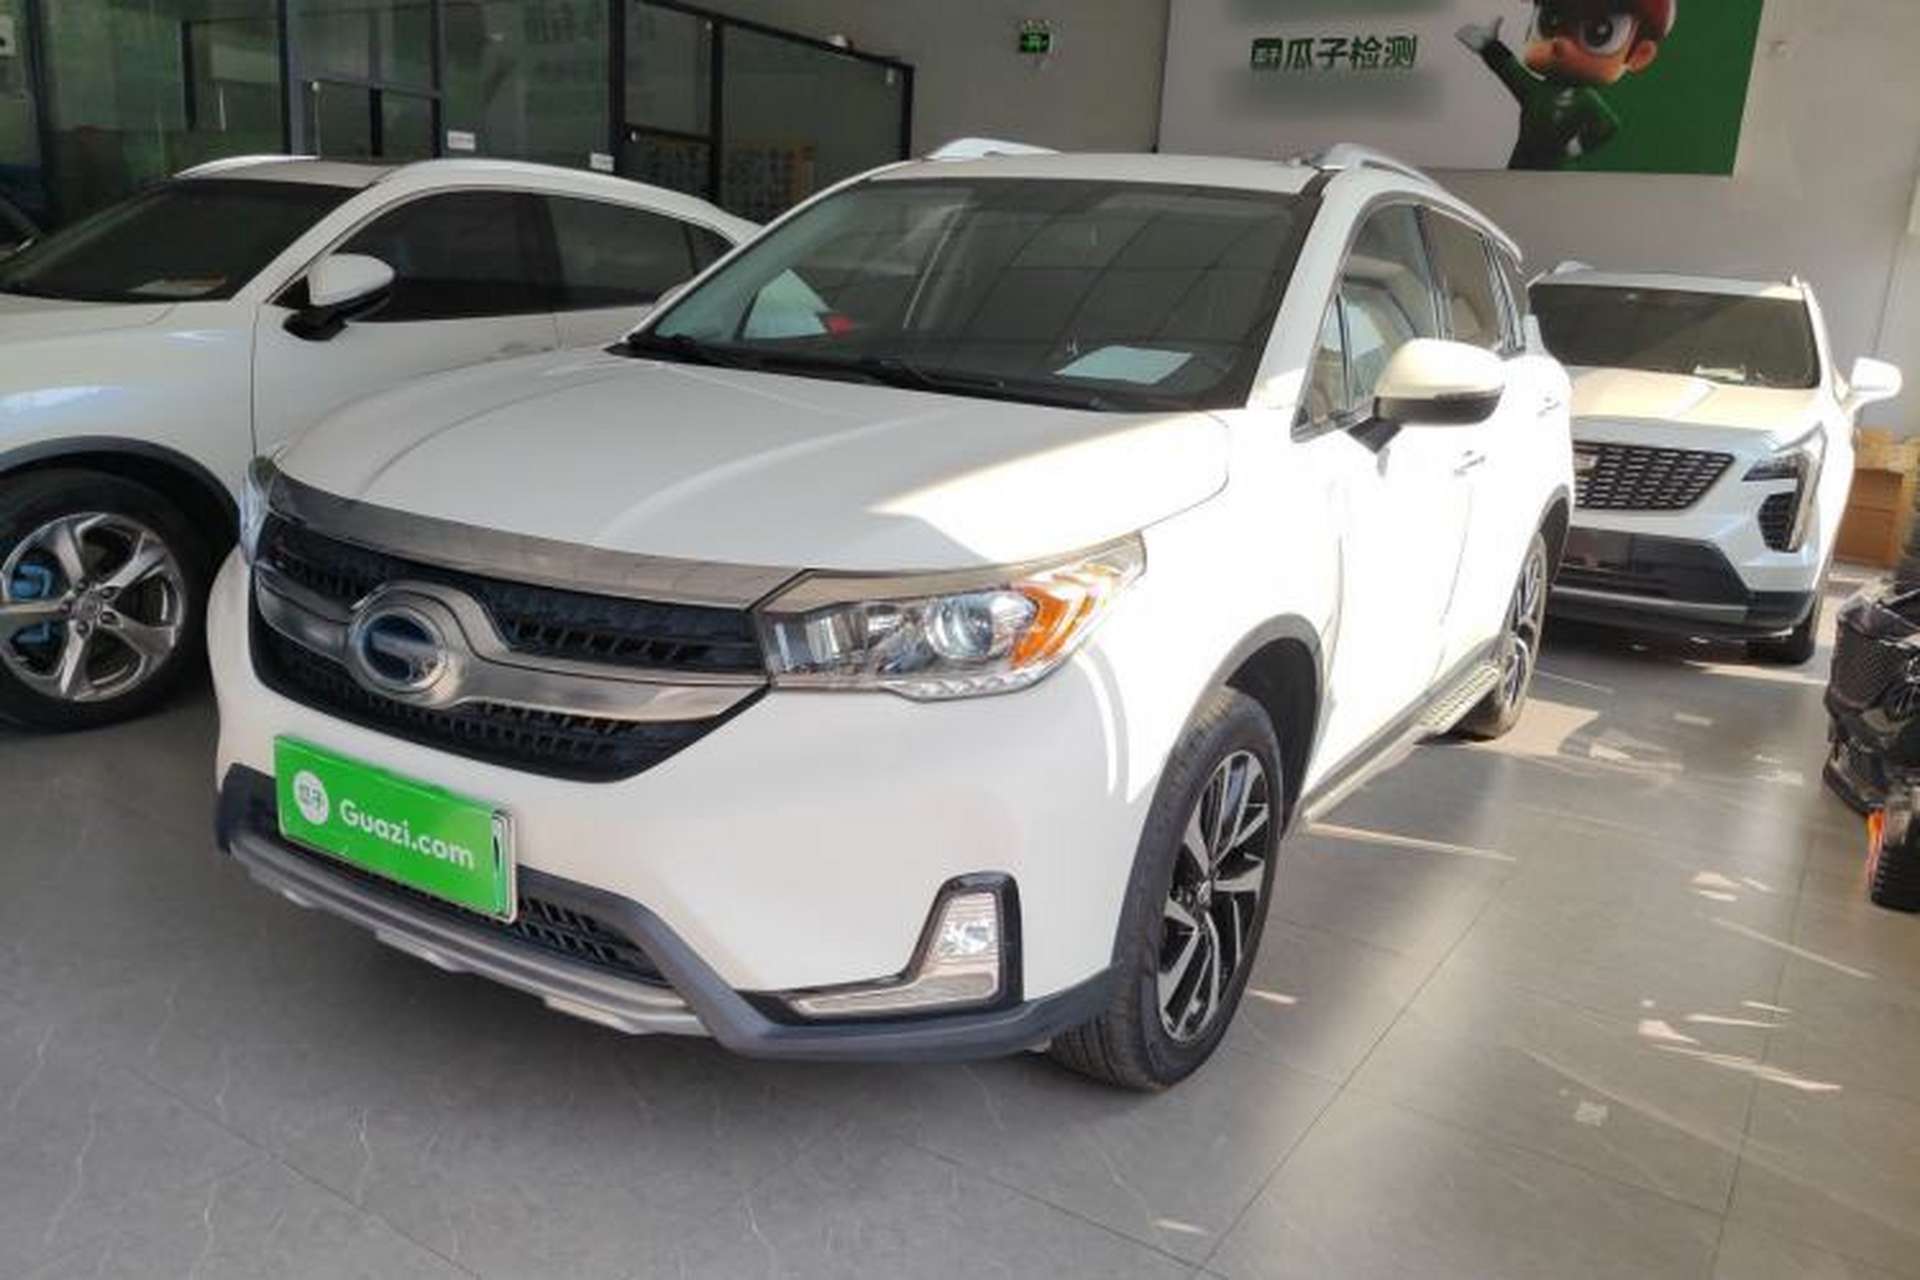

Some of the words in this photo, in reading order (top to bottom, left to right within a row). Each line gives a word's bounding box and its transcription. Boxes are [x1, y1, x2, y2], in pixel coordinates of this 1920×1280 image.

[1286, 35, 1417, 69] 瓜子检测
[339, 798, 475, 870] Guazi.com
